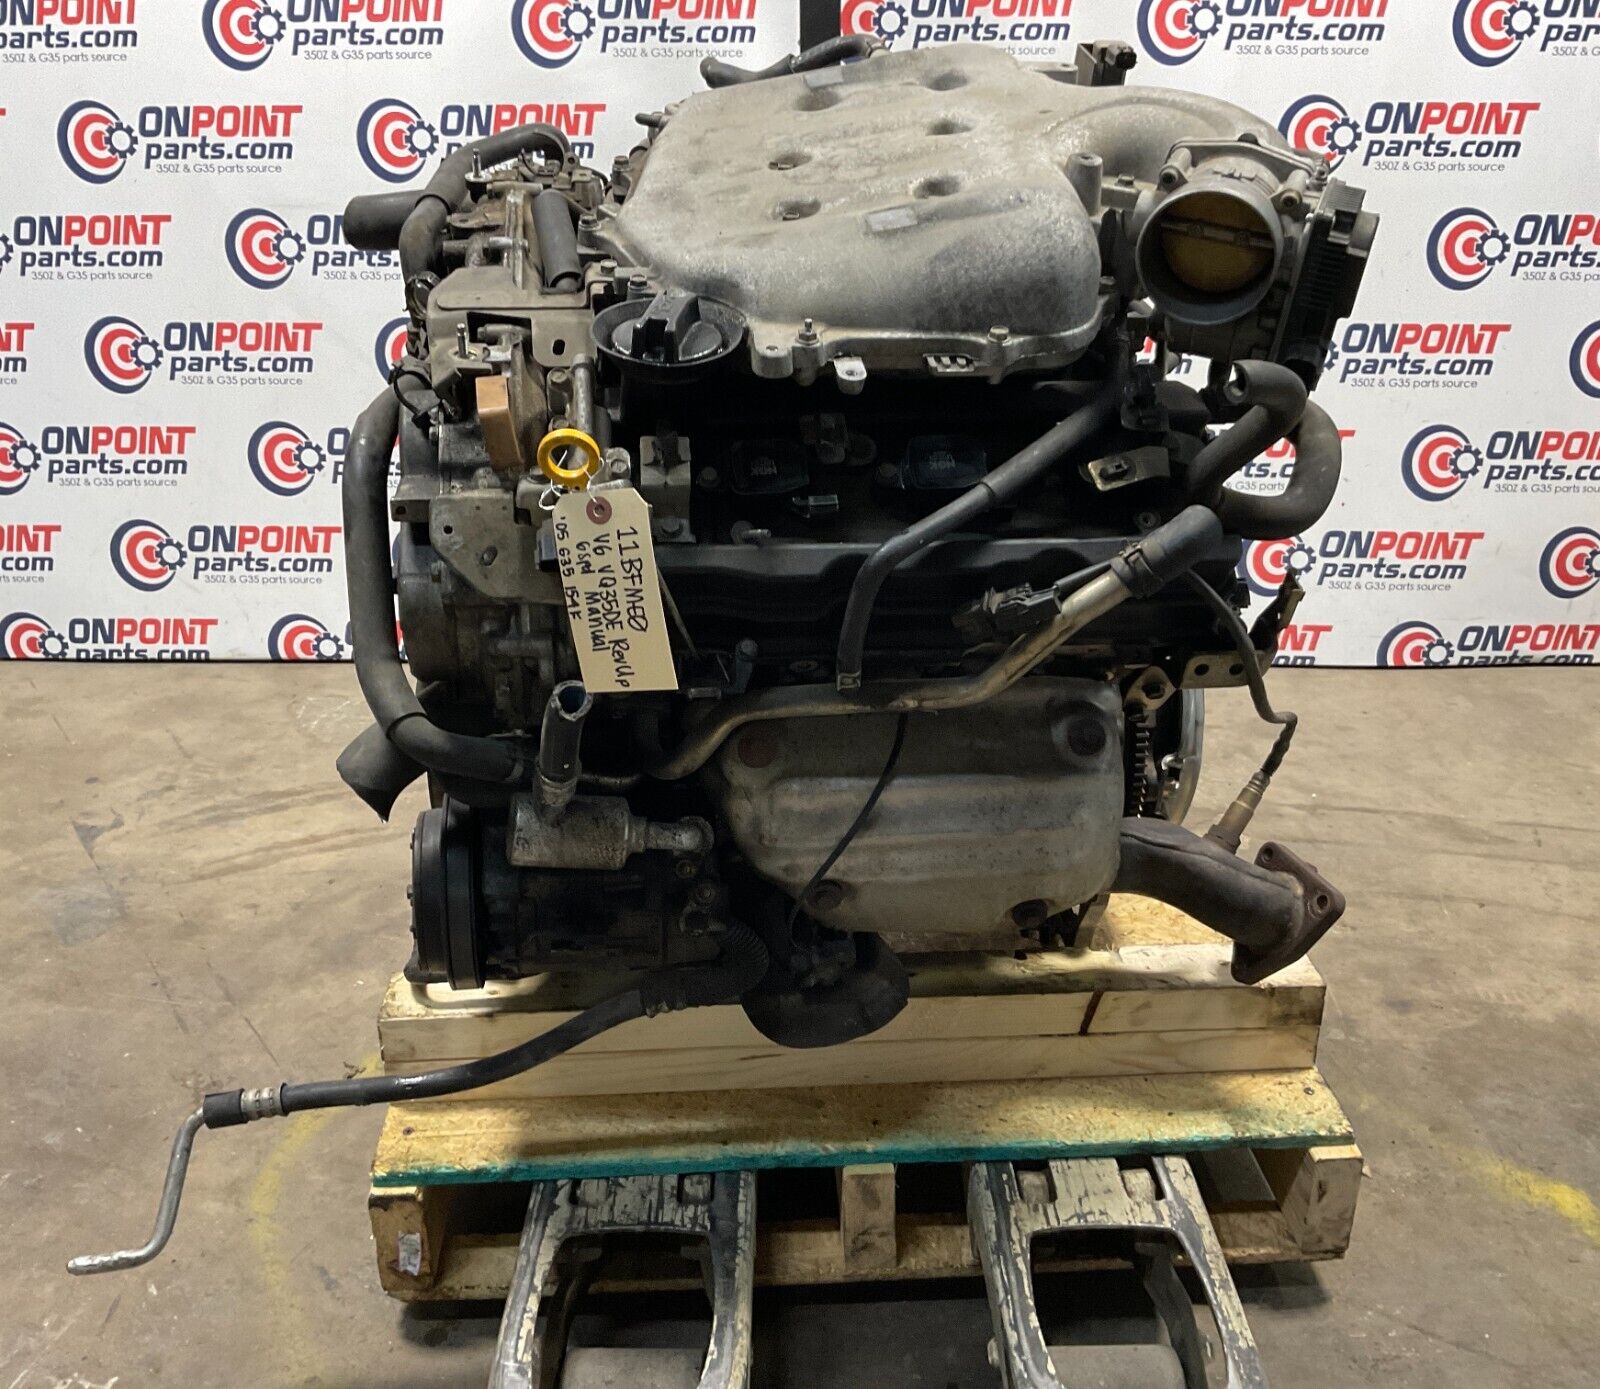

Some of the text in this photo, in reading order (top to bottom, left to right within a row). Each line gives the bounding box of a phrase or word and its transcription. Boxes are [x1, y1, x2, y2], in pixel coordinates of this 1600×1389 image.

[292, 21, 443, 56] parts.com
[601, 18, 755, 53] parts.com
[913, 16, 1070, 49] parts.com
[1225, 16, 1384, 50] parts.com
[3, 52, 127, 64] 350Z & G35 parts source
[304, 50, 432, 61] 350Z & G35 parts source
[613, 48, 742, 58] 350Z & G35 parts source
[1236, 45, 1369, 56] 350Z & G35 parts source
[139, 105, 303, 137] ONPOINT
[440, 104, 606, 136] ONPOINT
[1365, 102, 1541, 134] ONPOINT
[144, 136, 292, 169] parts.com
[1362, 133, 1521, 166] parts.com
[156, 164, 179, 173] 350Z
[184, 164, 191, 173] &
[194, 164, 215, 173] G35
[218, 164, 243, 174] parts
[1374, 161, 1505, 172] 350Z & G35 parts source
[14, 215, 171, 246] ONPOINT
[20, 244, 162, 276] parts.com
[32, 271, 53, 280] 350Z
[57, 271, 64, 280] &
[67, 271, 87, 280] G35
[90, 271, 116, 281] parts
[324, 271, 346, 280] 350Z
[351, 271, 357, 280] &
[360, 271, 381, 280] G35
[1522, 272, 1546, 280] 350Z
[1549, 272, 1556, 280] &
[1560, 272, 1581, 280] G35
[164, 322, 323, 352] ONPOINT
[1342, 324, 1512, 354] ONPOINT
[170, 350, 313, 380] parts.com
[1340, 352, 1493, 383] parts.com
[181, 376, 303, 386] 350Z & G35 parts source
[1351, 378, 1477, 389] 350Z & G35 parts source
[41, 426, 196, 454] ONPOINT
[1486, 431, 1600, 460] ONPOI
[48, 453, 187, 482] parts.com
[59, 478, 80, 486] 350Z
[84, 478, 90, 486] &
[93, 478, 114, 486] G35
[117, 478, 141, 488] parts
[1235, 482, 1256, 490] G35
[1259, 482, 1285, 491] parts
[1495, 484, 1518, 493] 350Z
[1521, 484, 1527, 492] &
[1531, 484, 1552, 492] G35
[1554, 484, 1580, 494] parts
[188, 525, 342, 553] ONPOINT
[592, 533, 612, 555] V6
[1319, 531, 1485, 560] ONPOINT
[194, 551, 332, 579] parts.com
[1317, 558, 1466, 585] parts.com
[205, 575, 226, 583] 350Z
[229, 575, 236, 583] &
[239, 575, 259, 583] G35
[262, 575, 286, 584] parts
[1328, 581, 1351, 590] 350Z
[1355, 581, 1361, 590] &
[1364, 581, 1386, 590] G35
[1388, 582, 1414, 591] parts
[598, 565, 624, 630] VQ35DE
[69, 618, 218, 644] ONPOINT
[584, 592, 610, 652] Manual
[76, 643, 210, 660] artscom
[1457, 624, 1600, 651] ONPOINT
[1458, 650, 1594, 664] artscom
